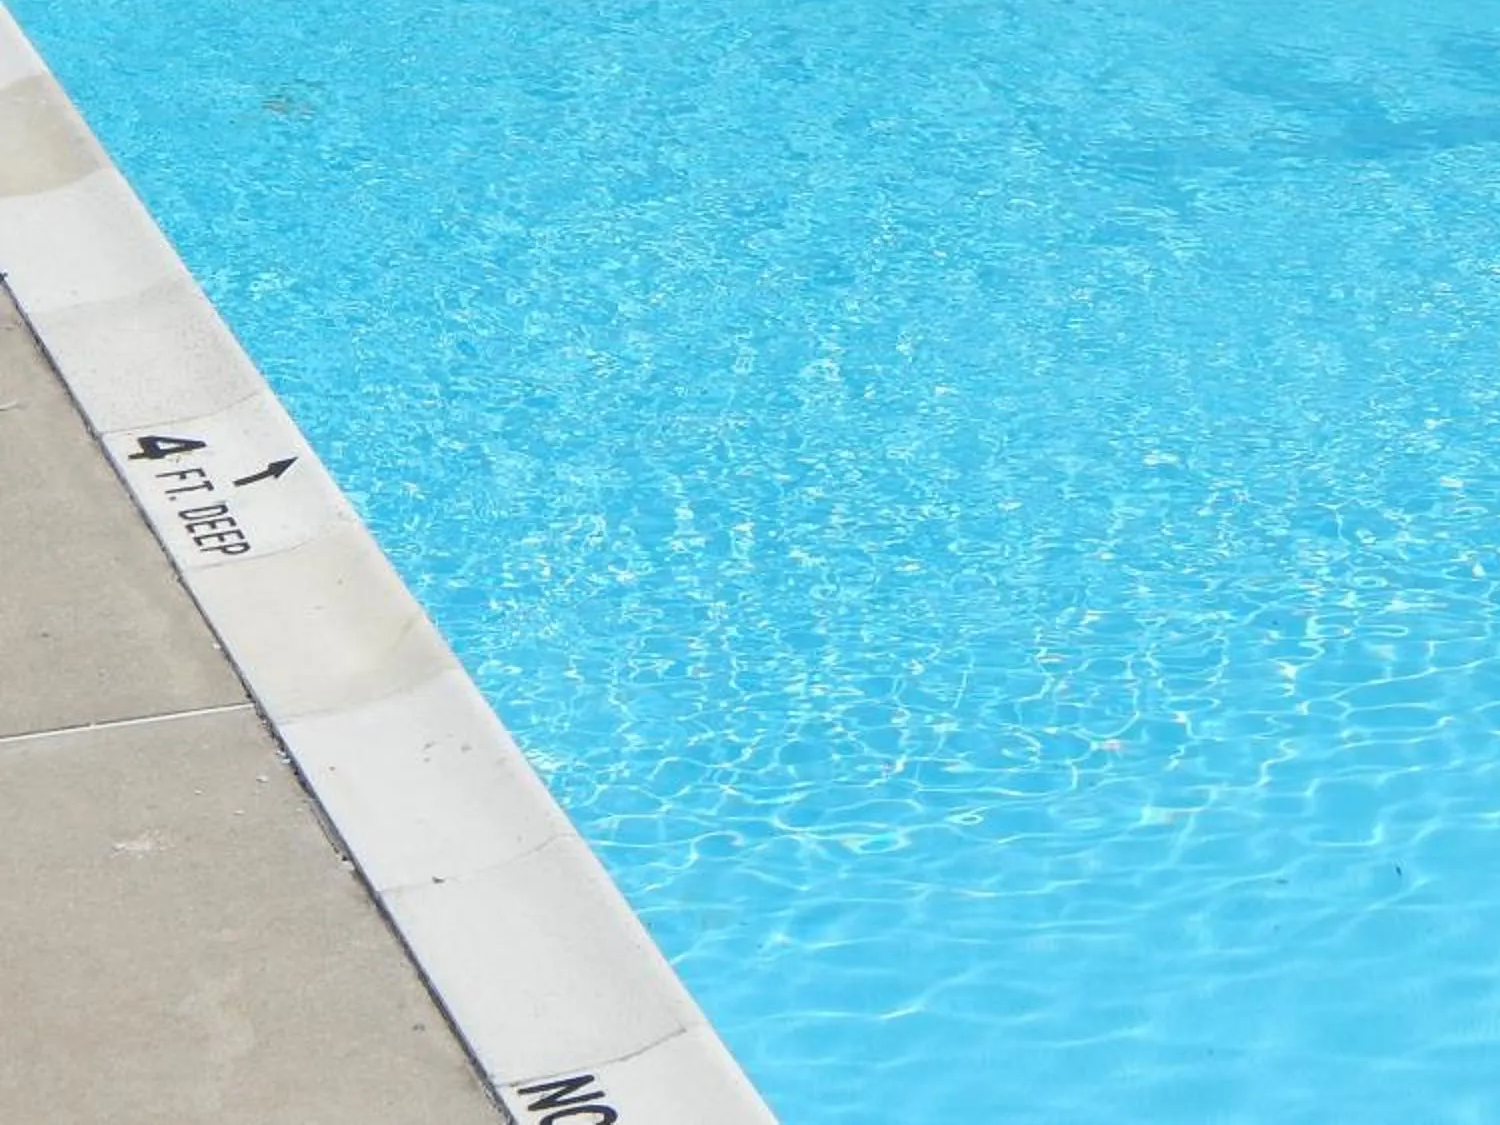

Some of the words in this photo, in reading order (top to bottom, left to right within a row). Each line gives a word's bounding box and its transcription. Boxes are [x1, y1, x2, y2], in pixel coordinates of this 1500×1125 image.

[127, 435, 207, 461] 4
[154, 467, 215, 502] FT.
[177, 503, 252, 556] DEEP
